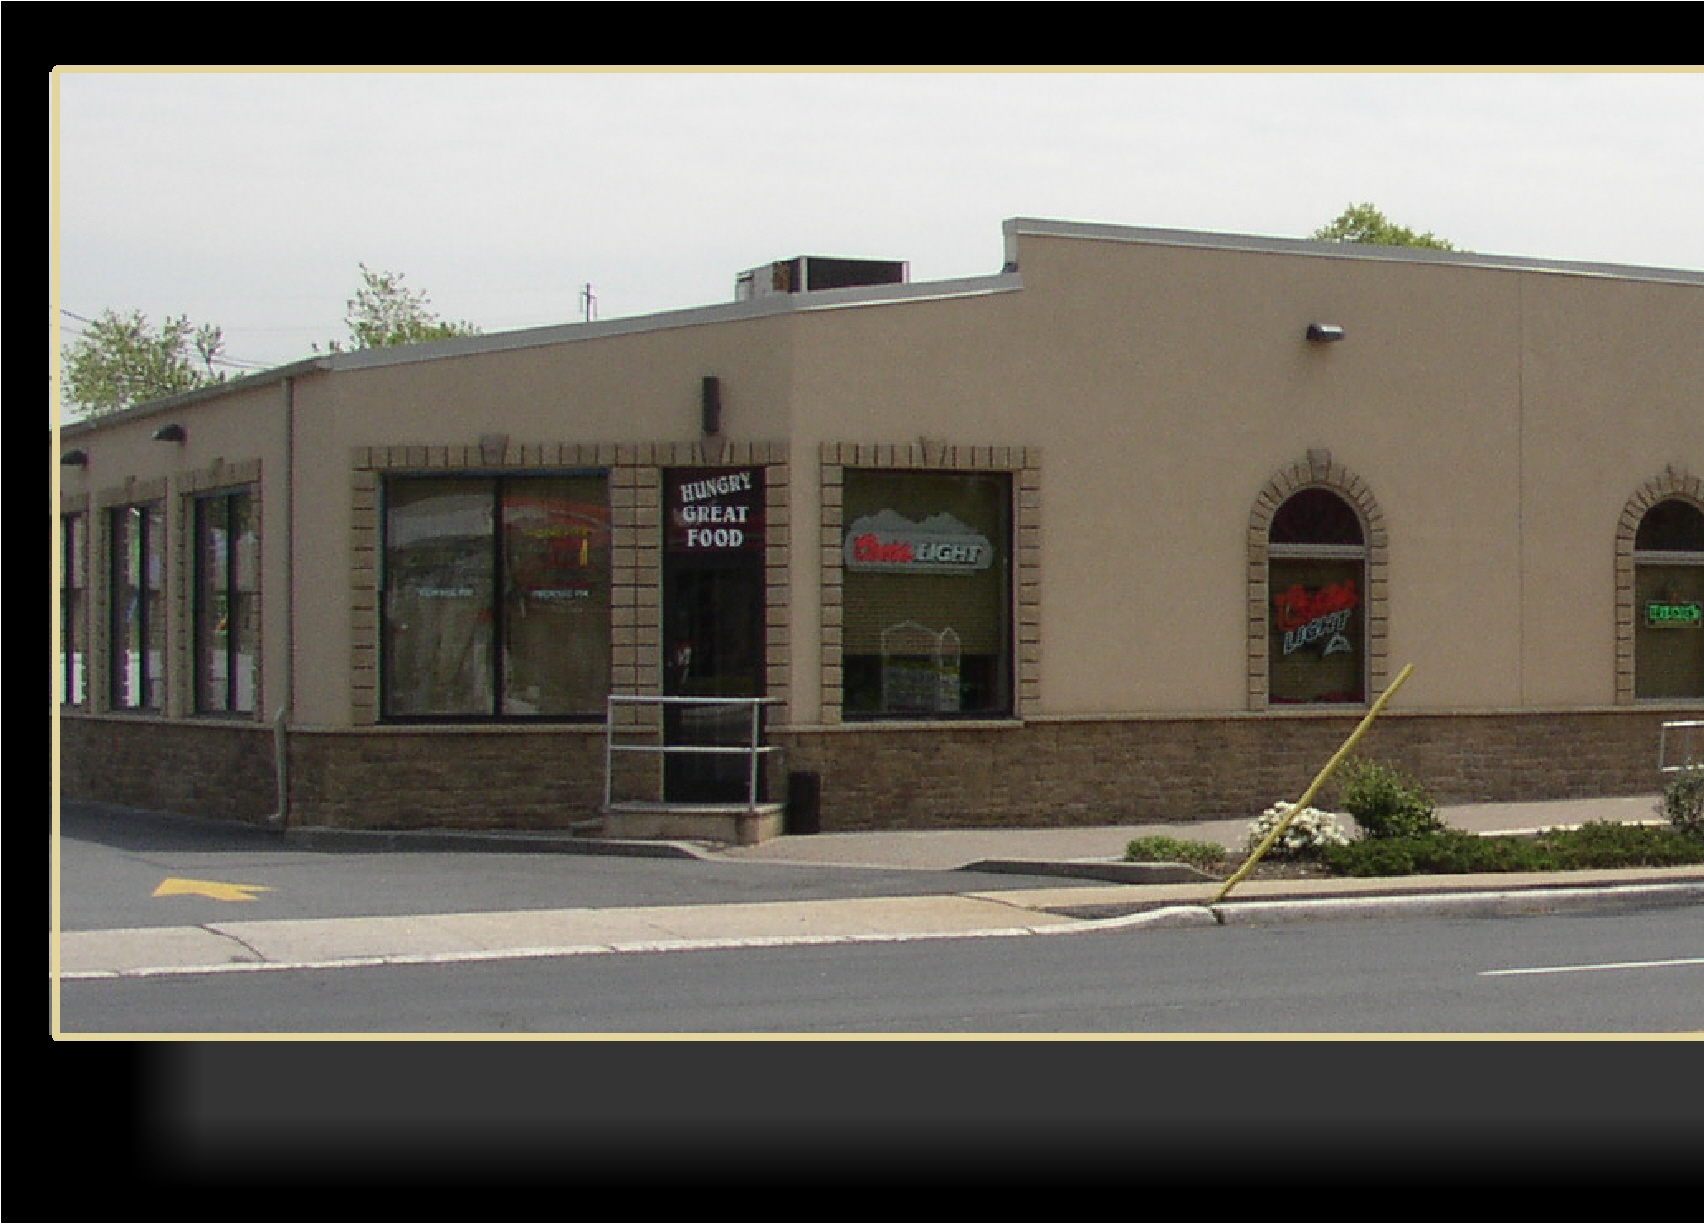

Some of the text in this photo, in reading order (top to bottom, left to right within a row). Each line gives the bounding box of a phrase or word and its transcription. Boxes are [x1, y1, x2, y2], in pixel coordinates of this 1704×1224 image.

[681, 472, 750, 502] HUNGRY
[683, 506, 748, 522] GREAT
[688, 529, 743, 547] FOOD
